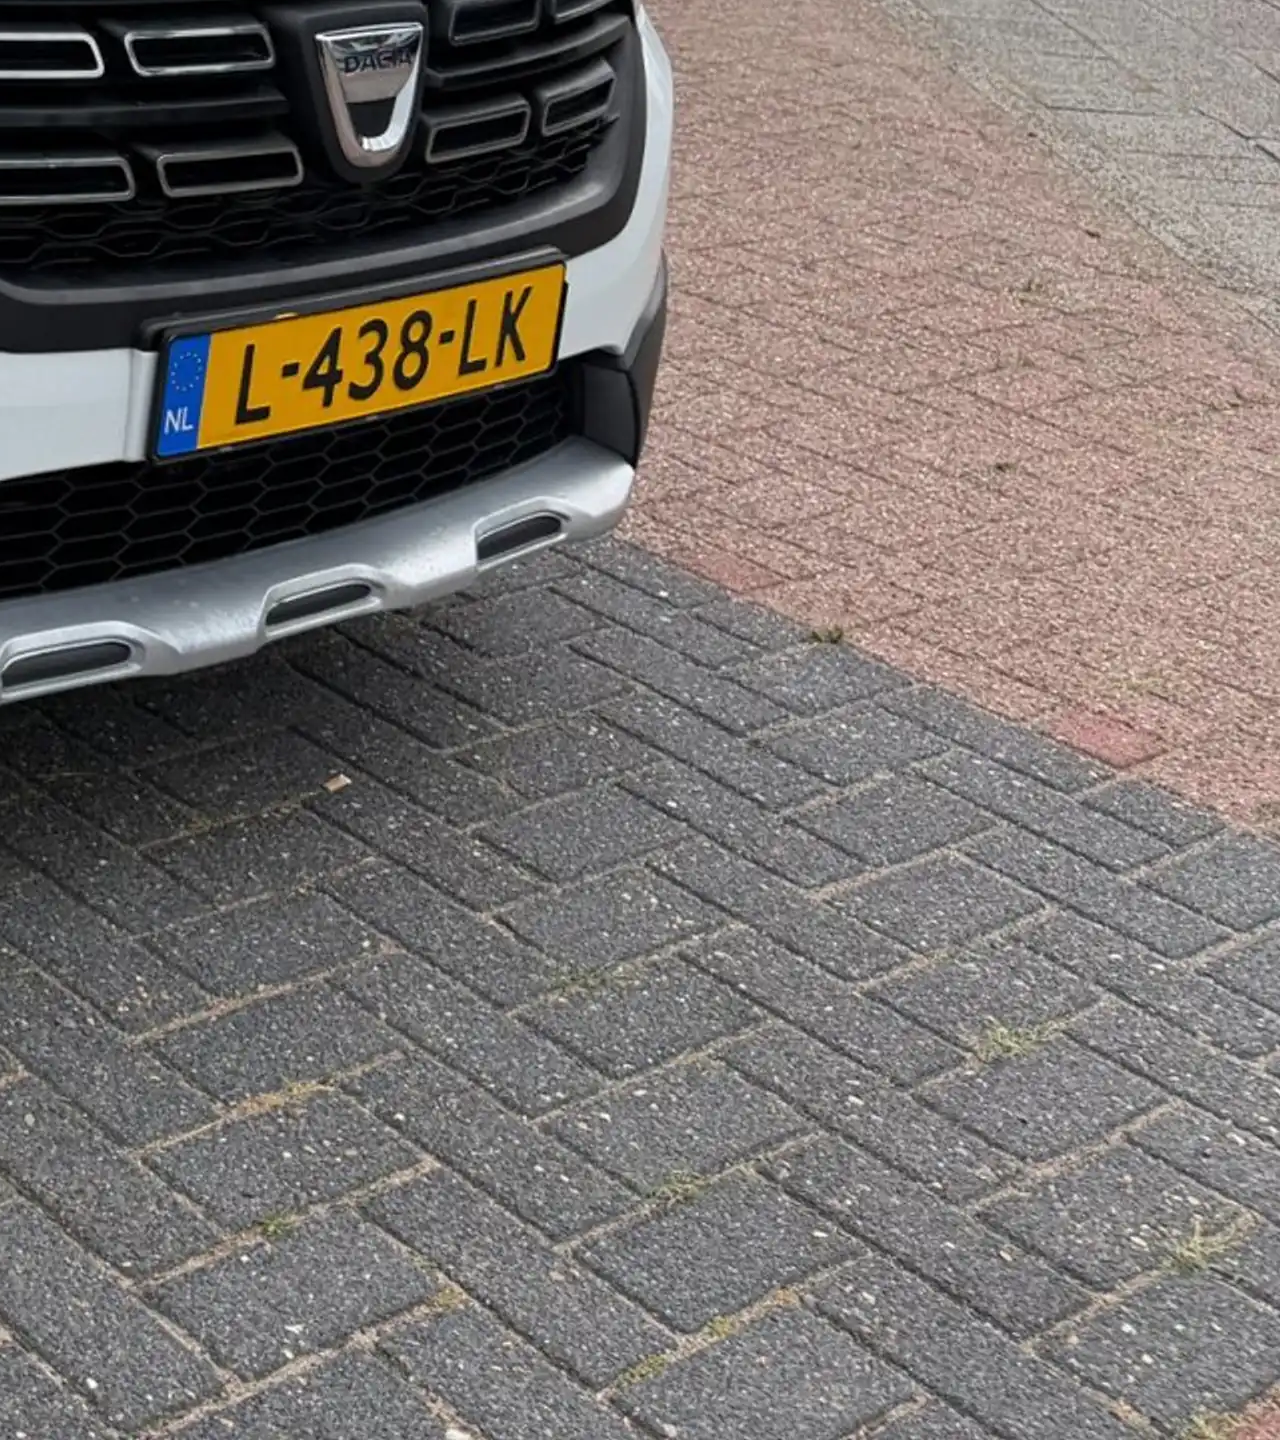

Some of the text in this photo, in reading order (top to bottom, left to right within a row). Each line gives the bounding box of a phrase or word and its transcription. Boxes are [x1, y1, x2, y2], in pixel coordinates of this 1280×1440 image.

[343, 47, 412, 73] DACIA
[234, 285, 534, 426] L-438-LK
[163, 408, 194, 435] NL
